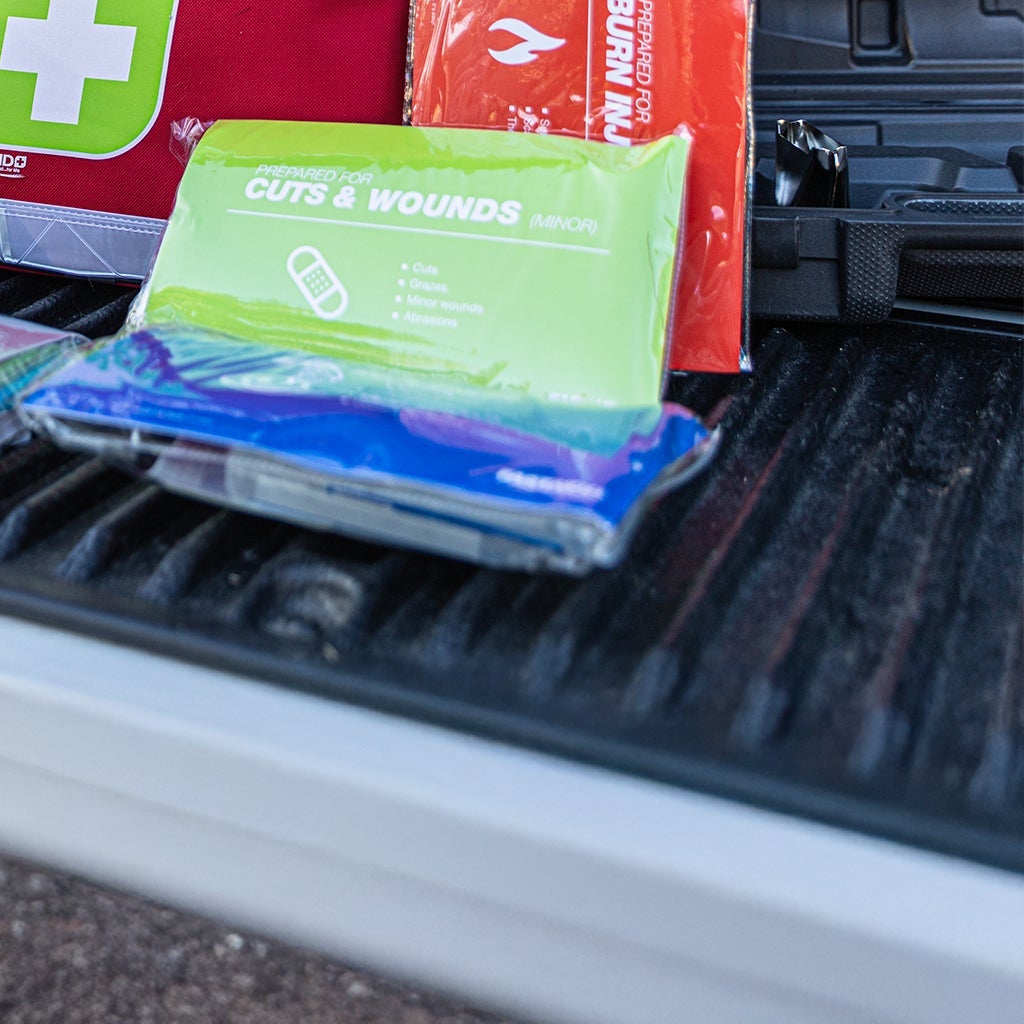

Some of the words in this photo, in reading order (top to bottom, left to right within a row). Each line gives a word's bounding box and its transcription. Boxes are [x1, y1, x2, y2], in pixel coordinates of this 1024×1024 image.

[636, 87, 651, 124] FOR
[255, 163, 337, 182] PREPARED
[338, 171, 374, 185] FOR
[244, 177, 330, 206] CUTS
[332, 185, 357, 209] &
[367, 188, 523, 226] WOUNDS
[529, 213, 598, 236] (MINOR)
[412, 261, 439, 276] Cuts
[409, 277, 448, 294] Grazes
[406, 293, 438, 309] Minor
[440, 300, 484, 315] wounds
[402, 310, 458, 329] Abrasions
